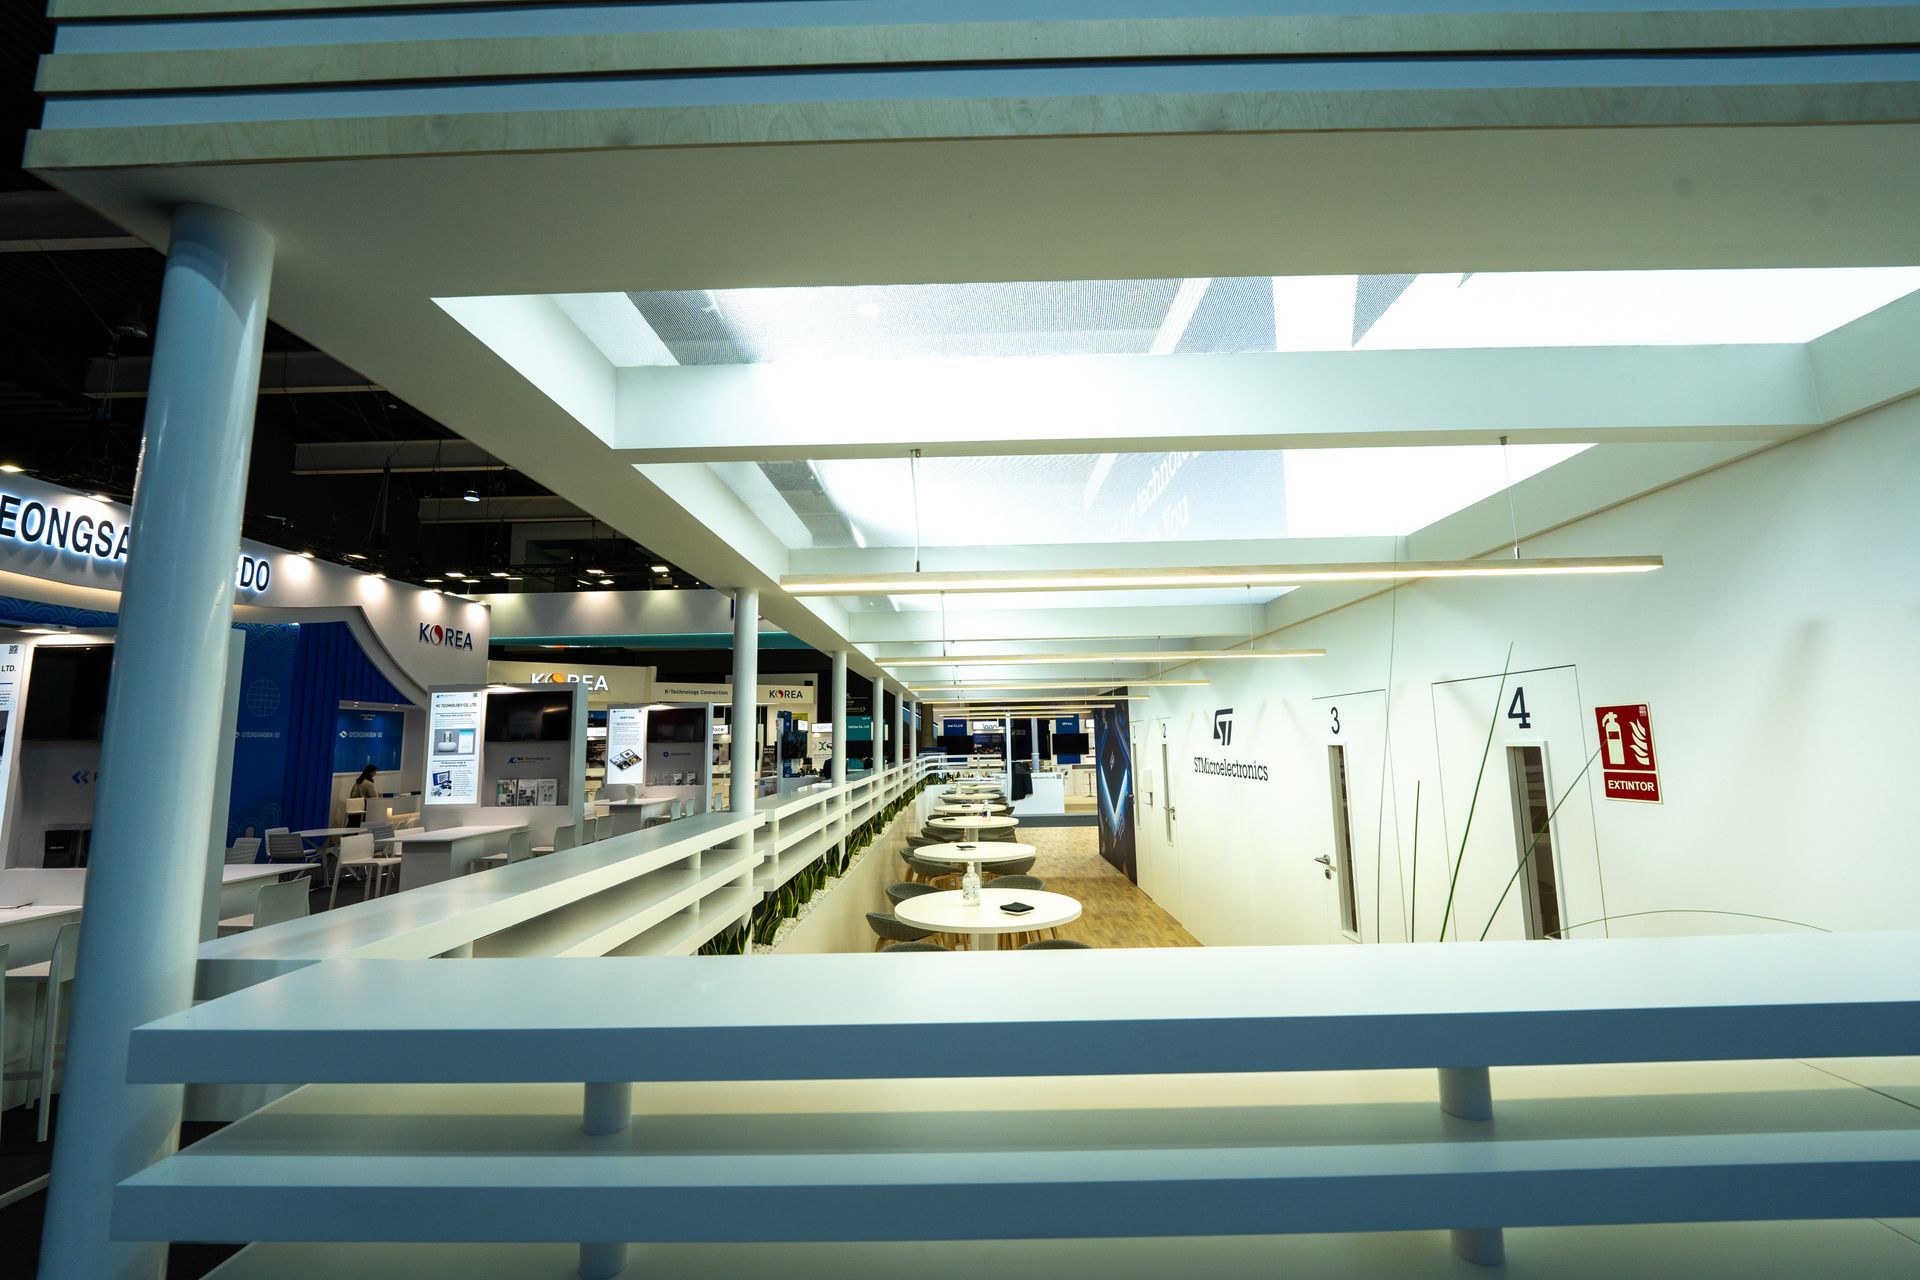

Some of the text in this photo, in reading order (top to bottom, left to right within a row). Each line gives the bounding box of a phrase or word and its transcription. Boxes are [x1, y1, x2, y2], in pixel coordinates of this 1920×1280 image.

[419, 622, 473, 650] KOREA
[769, 690, 803, 699] KOREA
[1507, 686, 1532, 729] 4
[1162, 723, 1167, 738] 2
[1330, 706, 1340, 735] 3
[1193, 756, 1269, 781] STMicroelectronics
[1607, 780, 1655, 791] EXTINTOR
